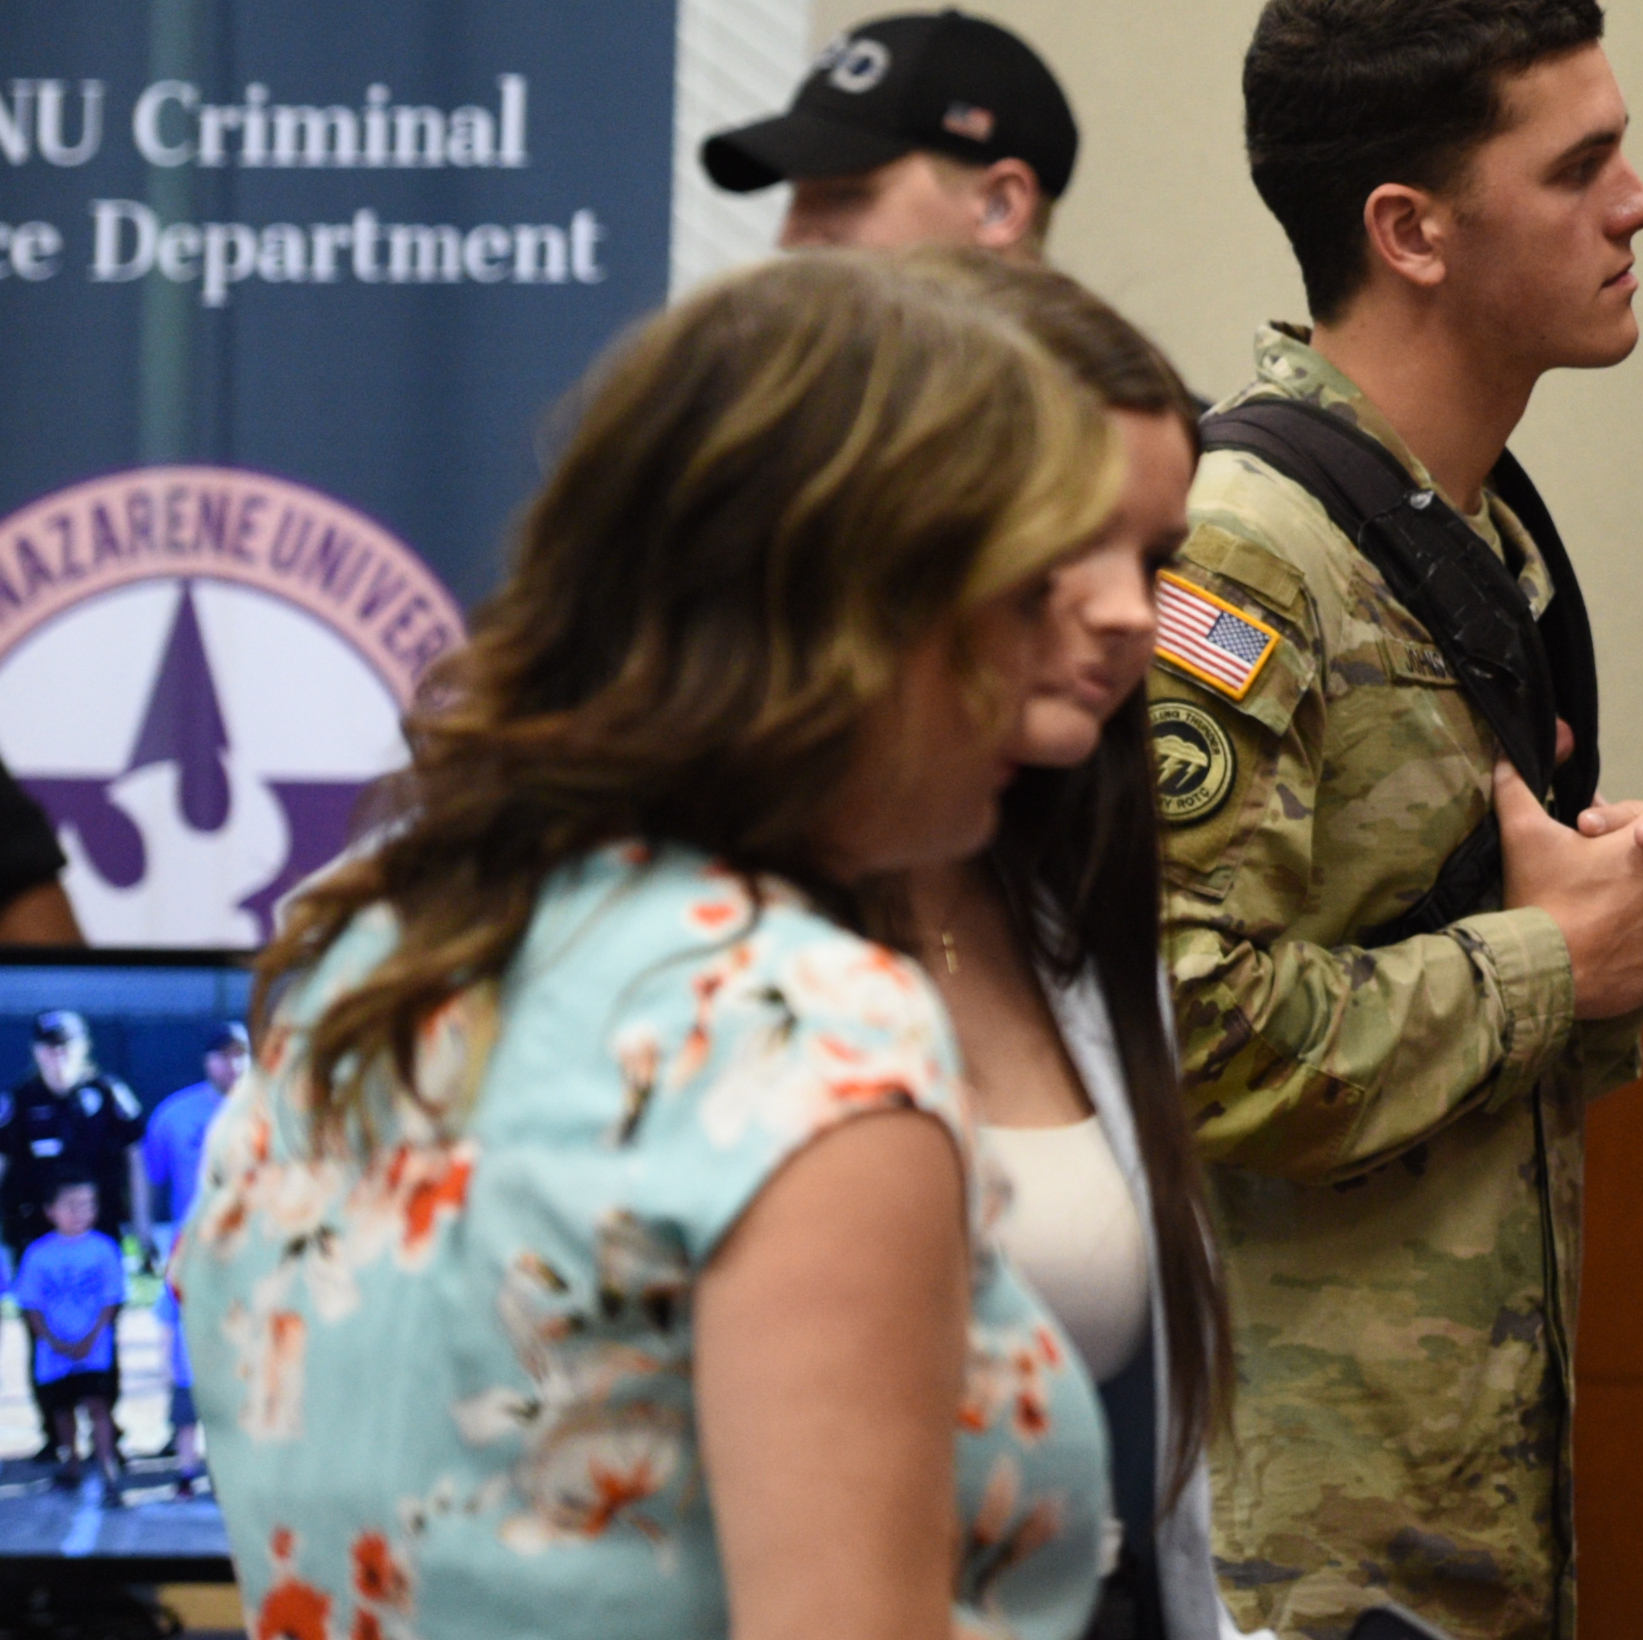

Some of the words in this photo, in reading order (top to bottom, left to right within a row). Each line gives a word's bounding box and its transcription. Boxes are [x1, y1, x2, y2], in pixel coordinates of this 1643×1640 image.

[132, 72, 530, 168] Criminal
[87, 197, 606, 307] Department
[270, 507, 450, 680] UNIVER
[1185, 712, 1221, 756] THUNDER
[1177, 787, 1210, 809] ROTC
